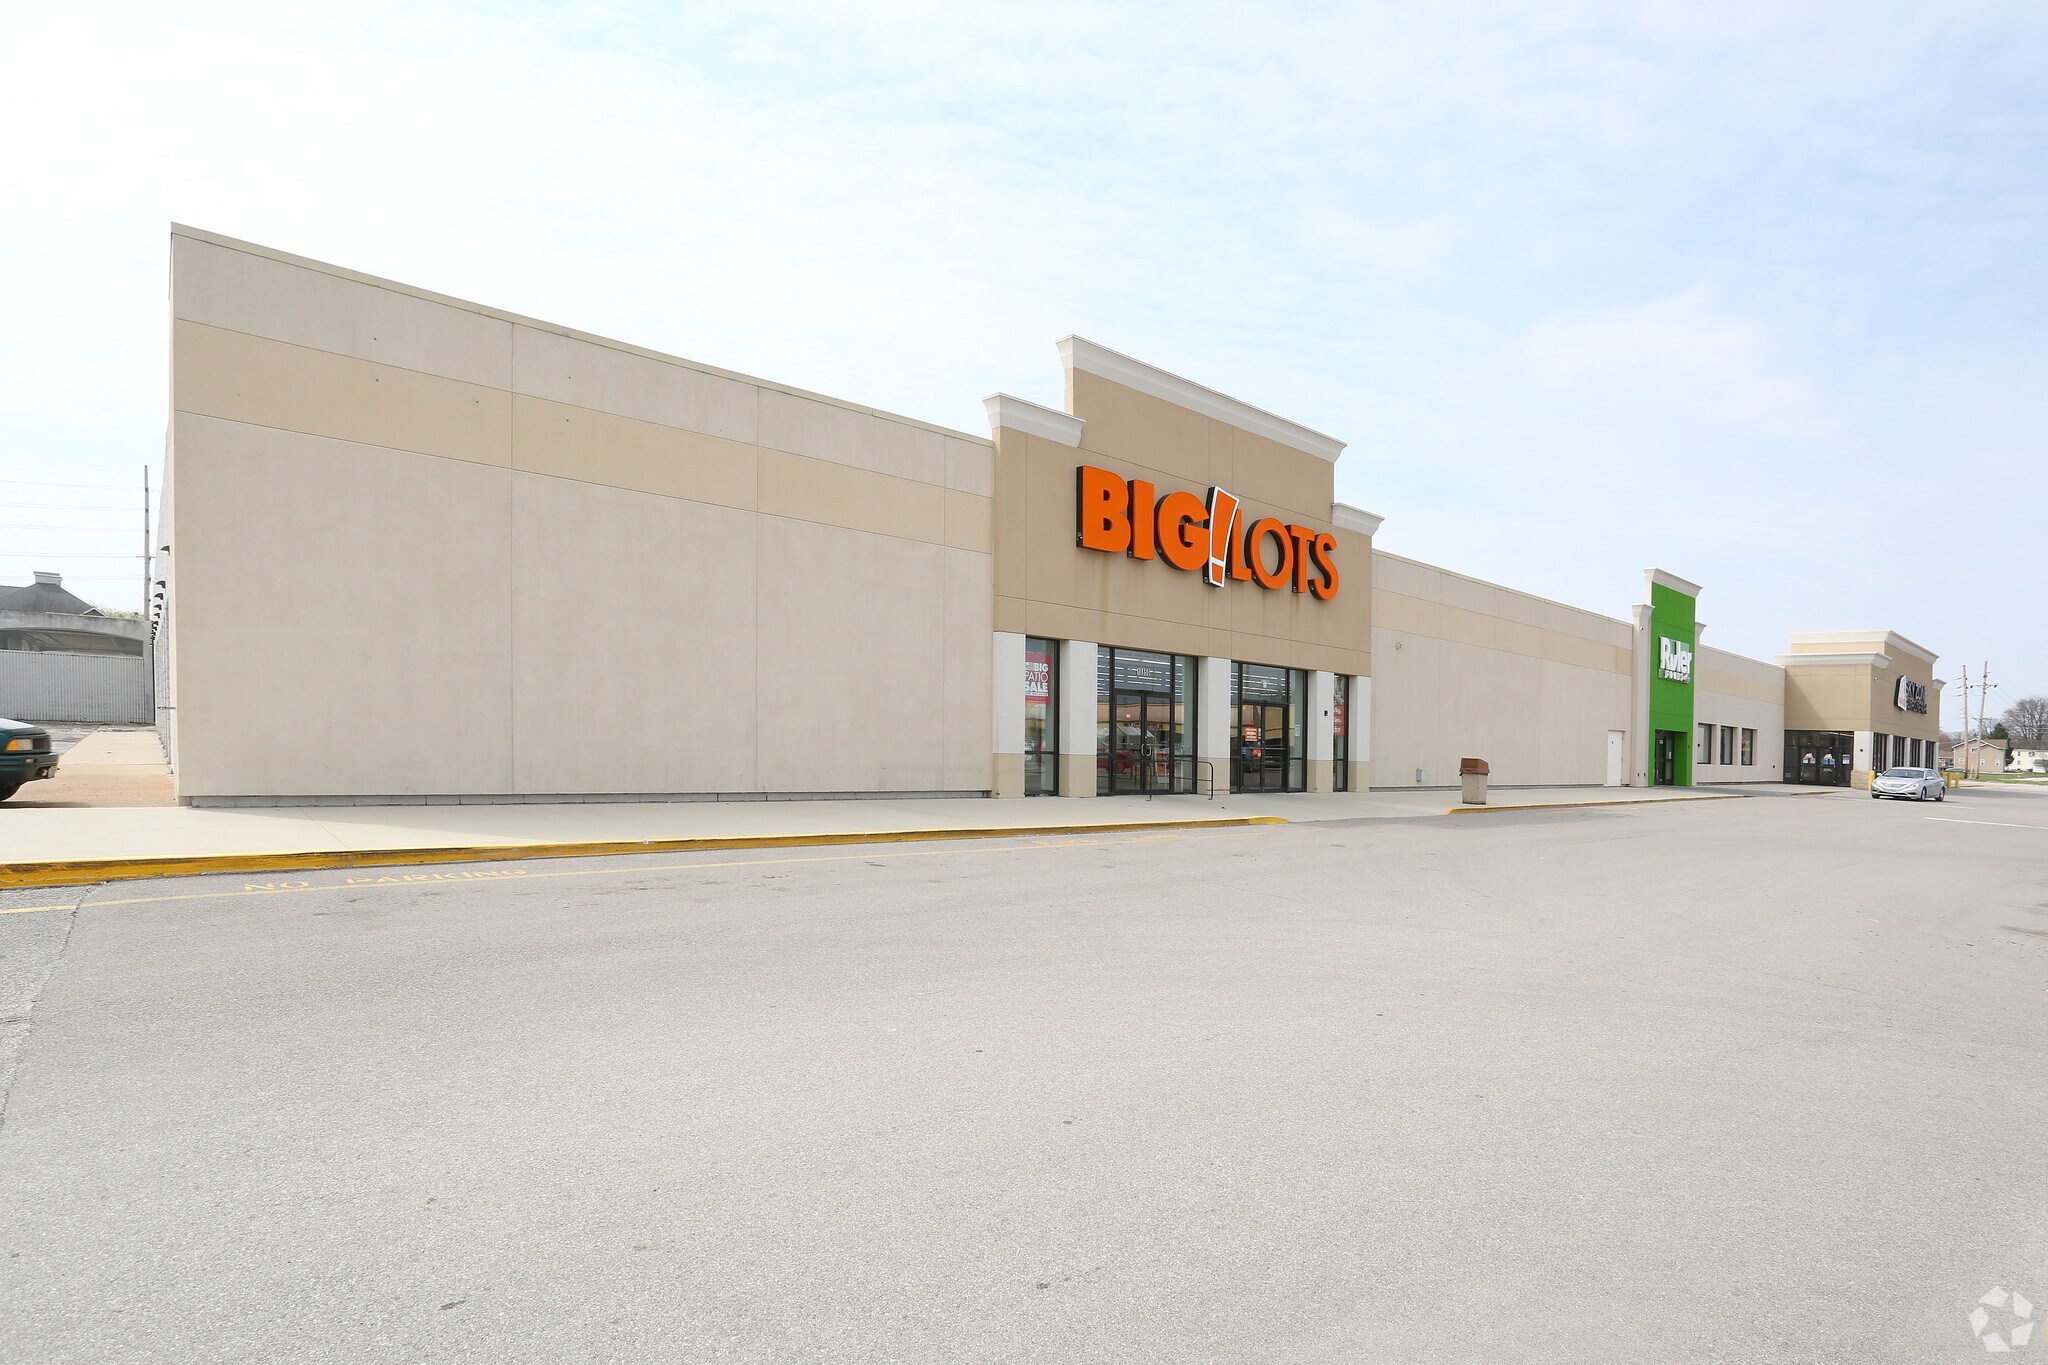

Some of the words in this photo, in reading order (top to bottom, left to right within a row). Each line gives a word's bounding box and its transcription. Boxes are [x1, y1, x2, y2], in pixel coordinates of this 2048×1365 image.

[1226, 509, 1339, 601] LOTS
[1659, 636, 1693, 675] Ruler
[1025, 670, 1049, 682] PATIO
[1025, 681, 1049, 693] SALE
[244, 881, 309, 890] NO
[346, 869, 527, 885] PARKING
